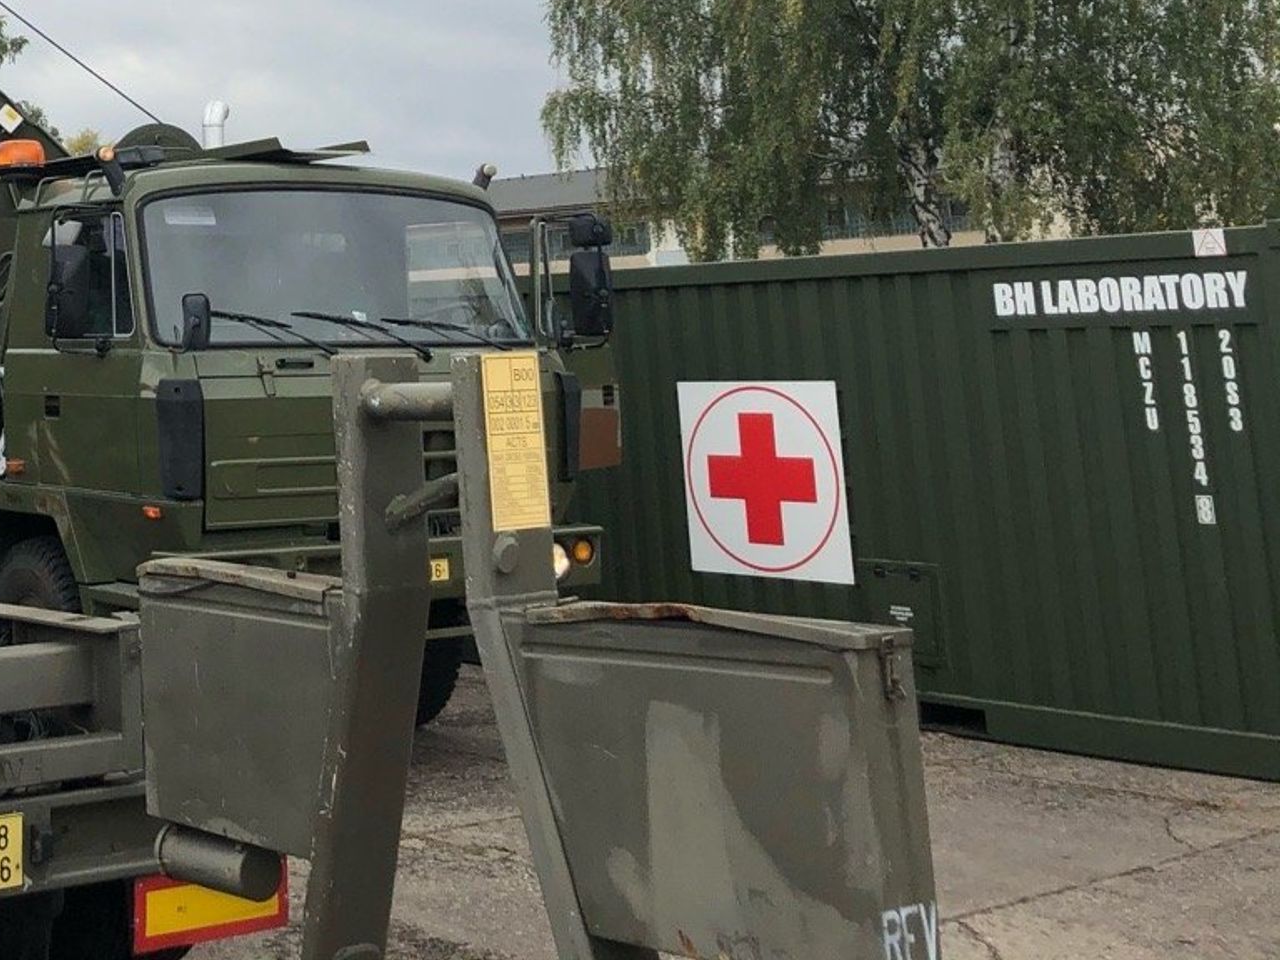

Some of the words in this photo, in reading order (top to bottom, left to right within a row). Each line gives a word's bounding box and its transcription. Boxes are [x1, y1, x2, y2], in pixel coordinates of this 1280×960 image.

[992, 281, 1037, 317] BH
[1040, 270, 1248, 315] LABORATORY
[1132, 331, 1160, 431] MCZU
